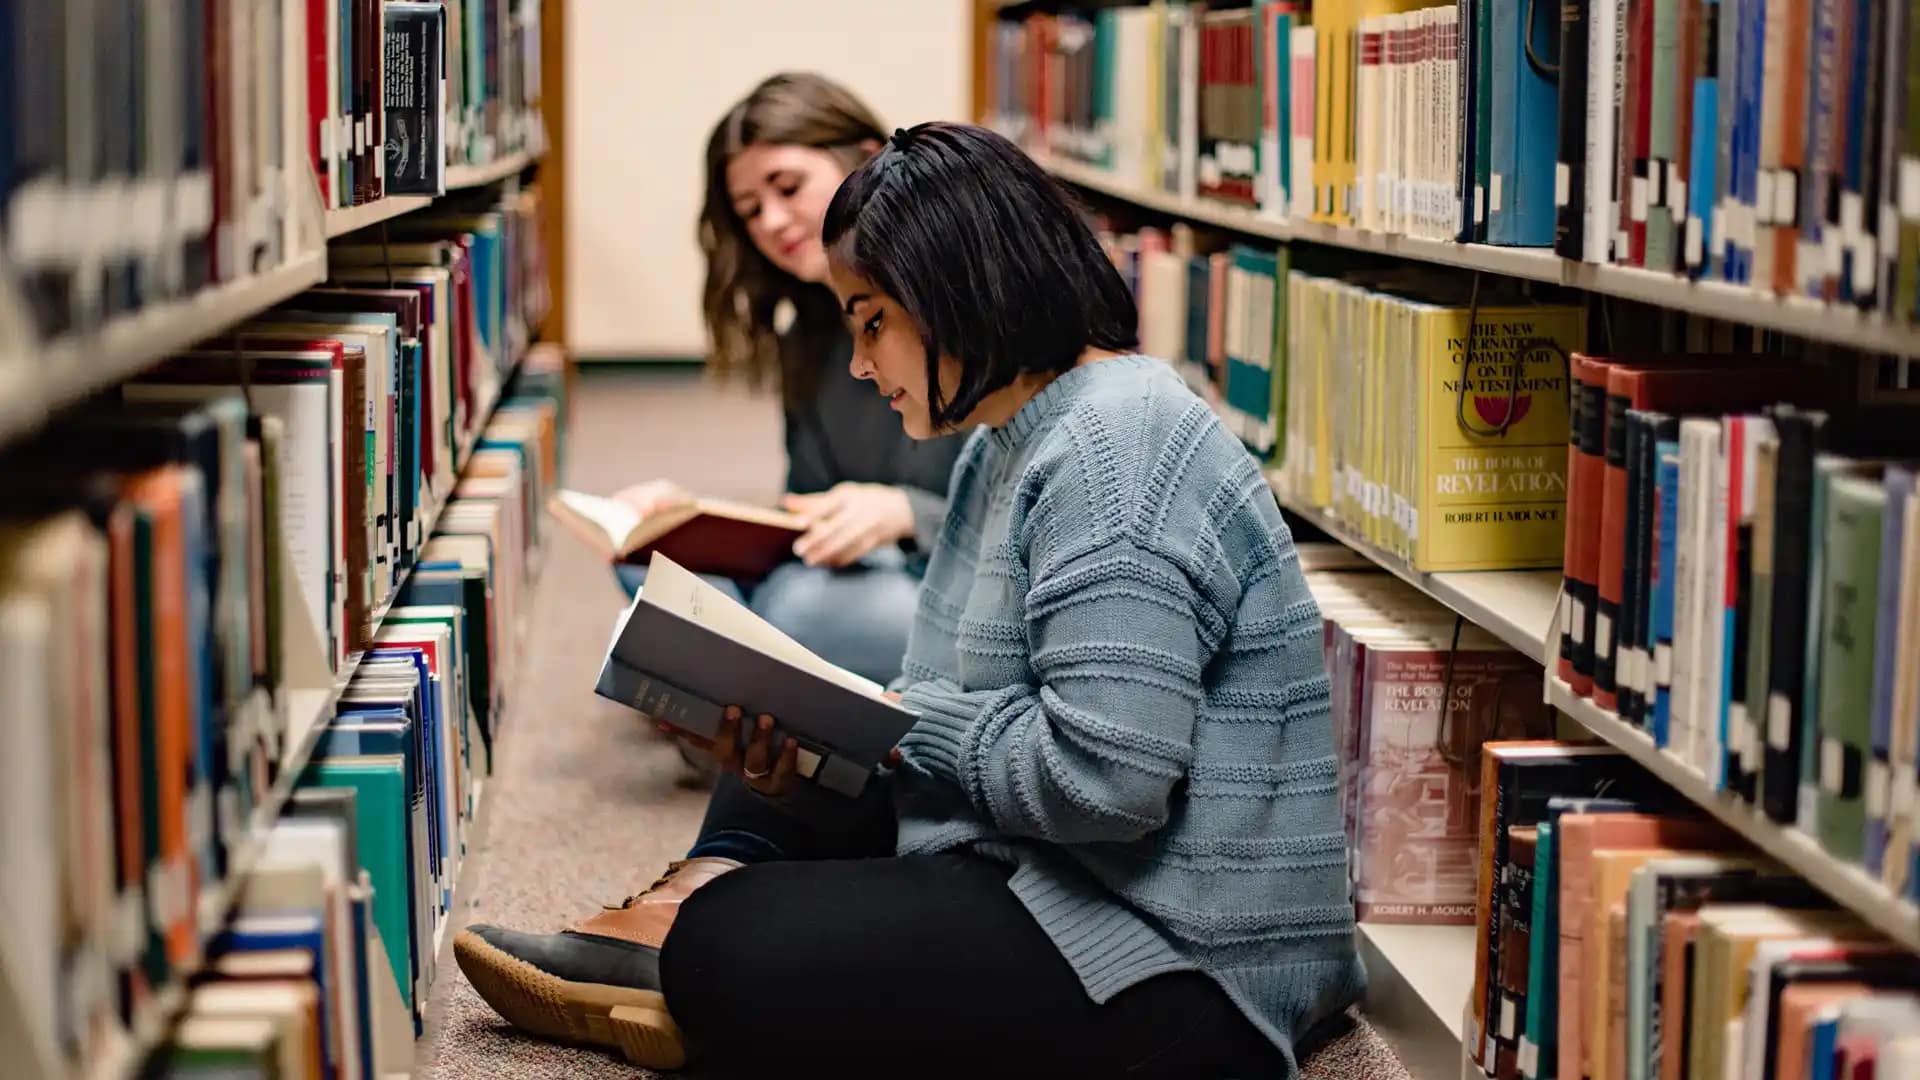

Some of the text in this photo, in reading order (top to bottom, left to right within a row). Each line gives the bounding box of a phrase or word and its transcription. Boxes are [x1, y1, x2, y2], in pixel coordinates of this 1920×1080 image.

[1471, 323, 1534, 336] THE NEW
[1452, 351, 1552, 364] CMMENTARY
[1477, 365, 1497, 377] ON
[1443, 380, 1474, 392] NEW
[1455, 456, 1544, 471] THE BOOK OF
[1436, 471, 1566, 494] REVELATION
[1445, 509, 1557, 523] ROBERT H. MOUNCE
[1386, 685, 1473, 697] THE BOO OF
[1384, 699, 1471, 711] REVELATON
[1373, 904, 1414, 915] ROBERT
[1432, 904, 1477, 916] MOUNC
